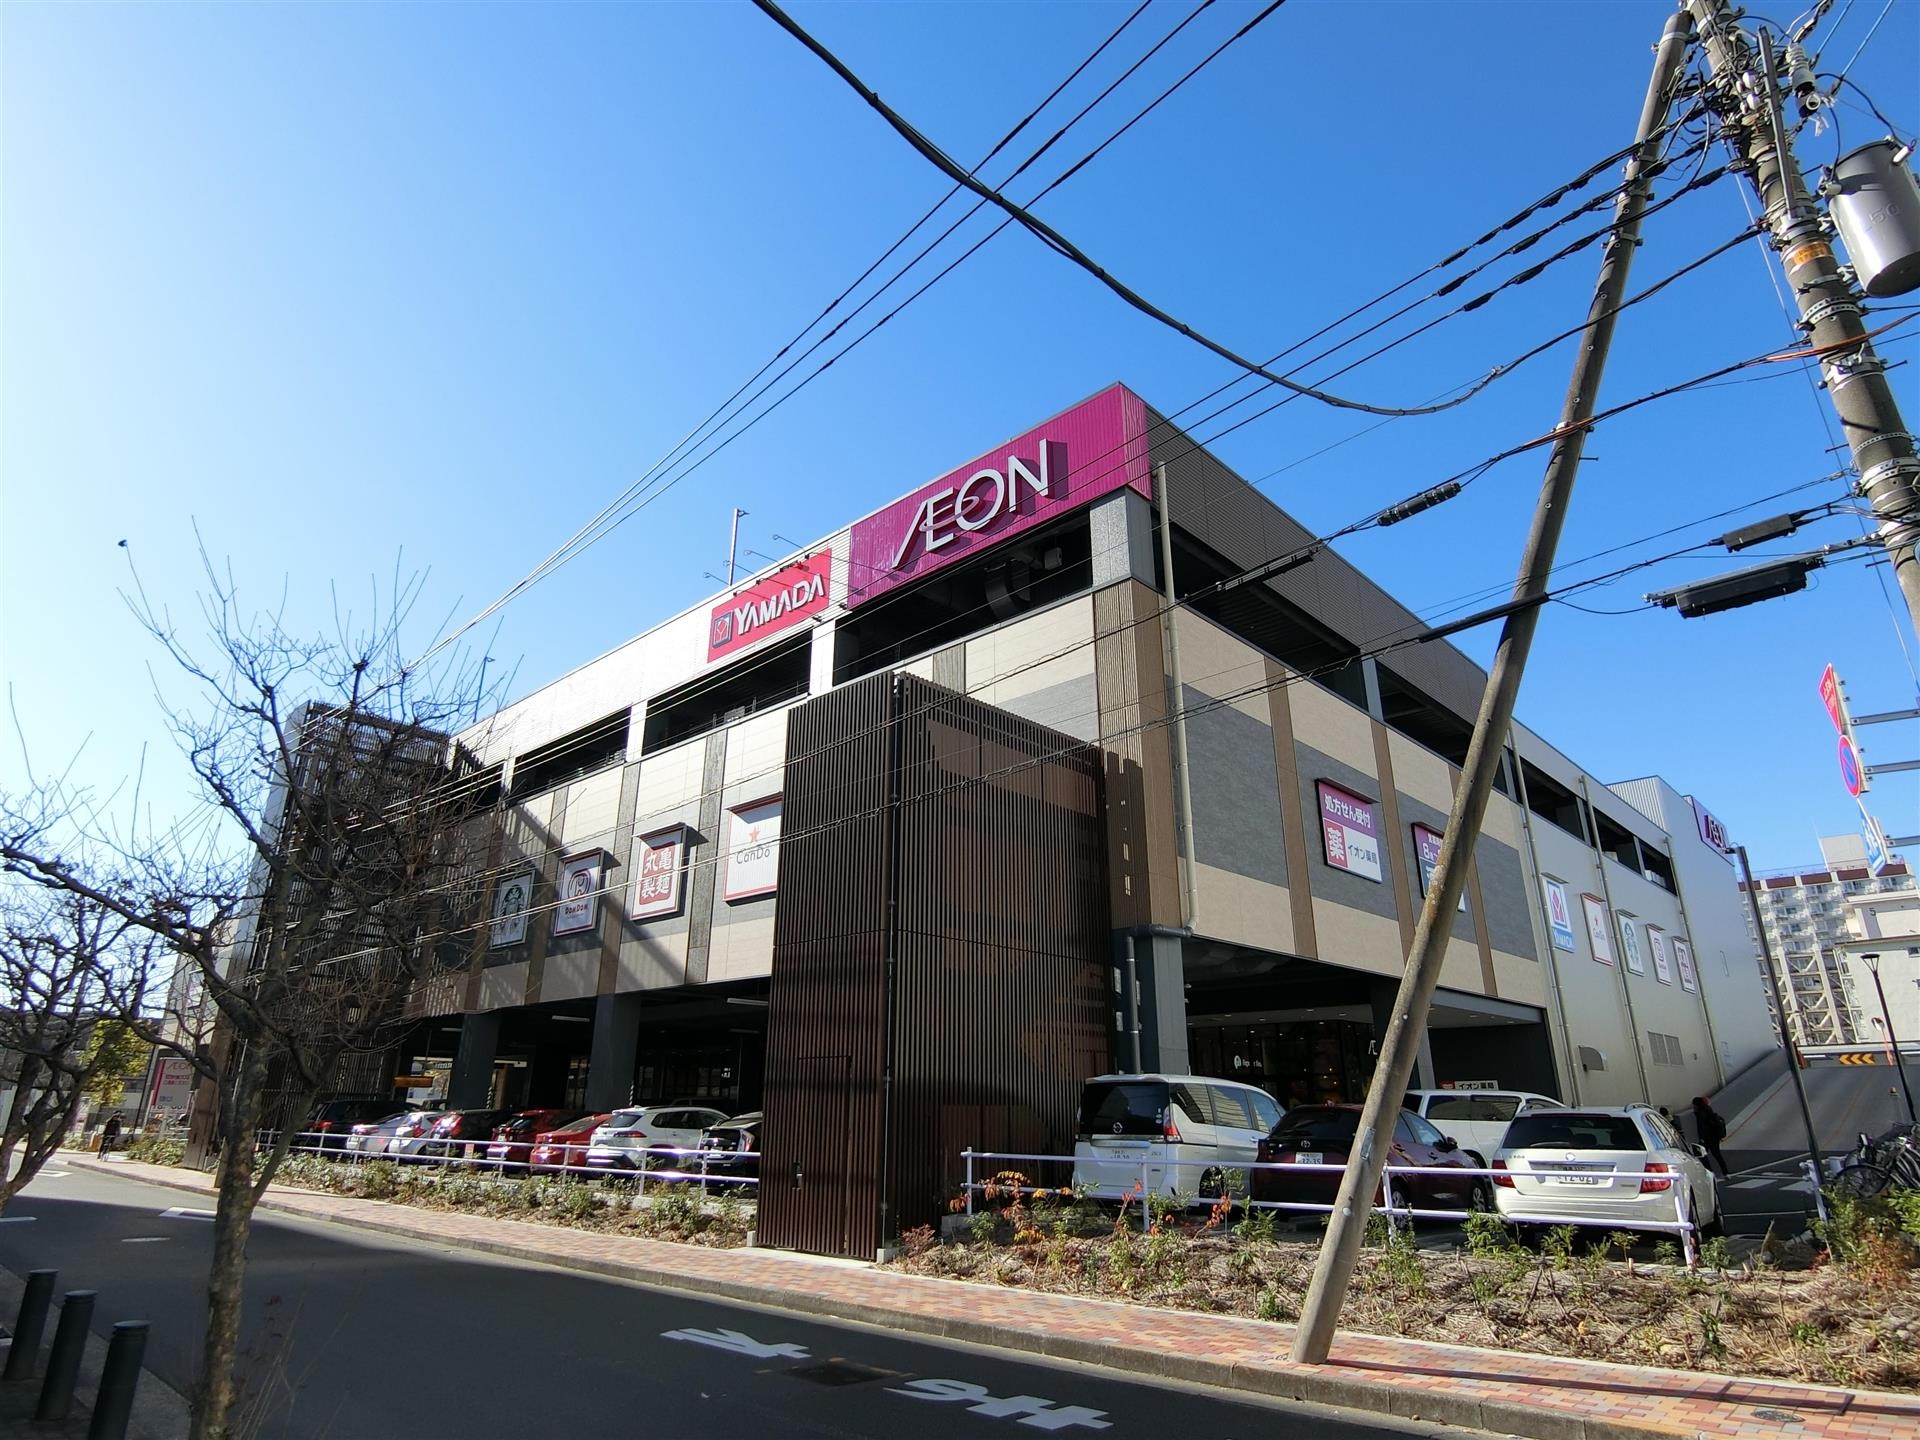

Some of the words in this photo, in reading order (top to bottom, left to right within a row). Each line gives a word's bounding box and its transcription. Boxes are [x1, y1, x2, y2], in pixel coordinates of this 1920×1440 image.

[734, 573, 824, 635] YAMADA
[1325, 793, 1371, 828] 処方せん受付
[736, 845, 771, 864] CanDo
[1328, 827, 1344, 860] 薬
[1347, 844, 1378, 865] イオン薬局
[644, 849, 672, 875] 丸亀
[641, 874, 671, 898] 製麺
[1869, 907, 1876, 916] 5
